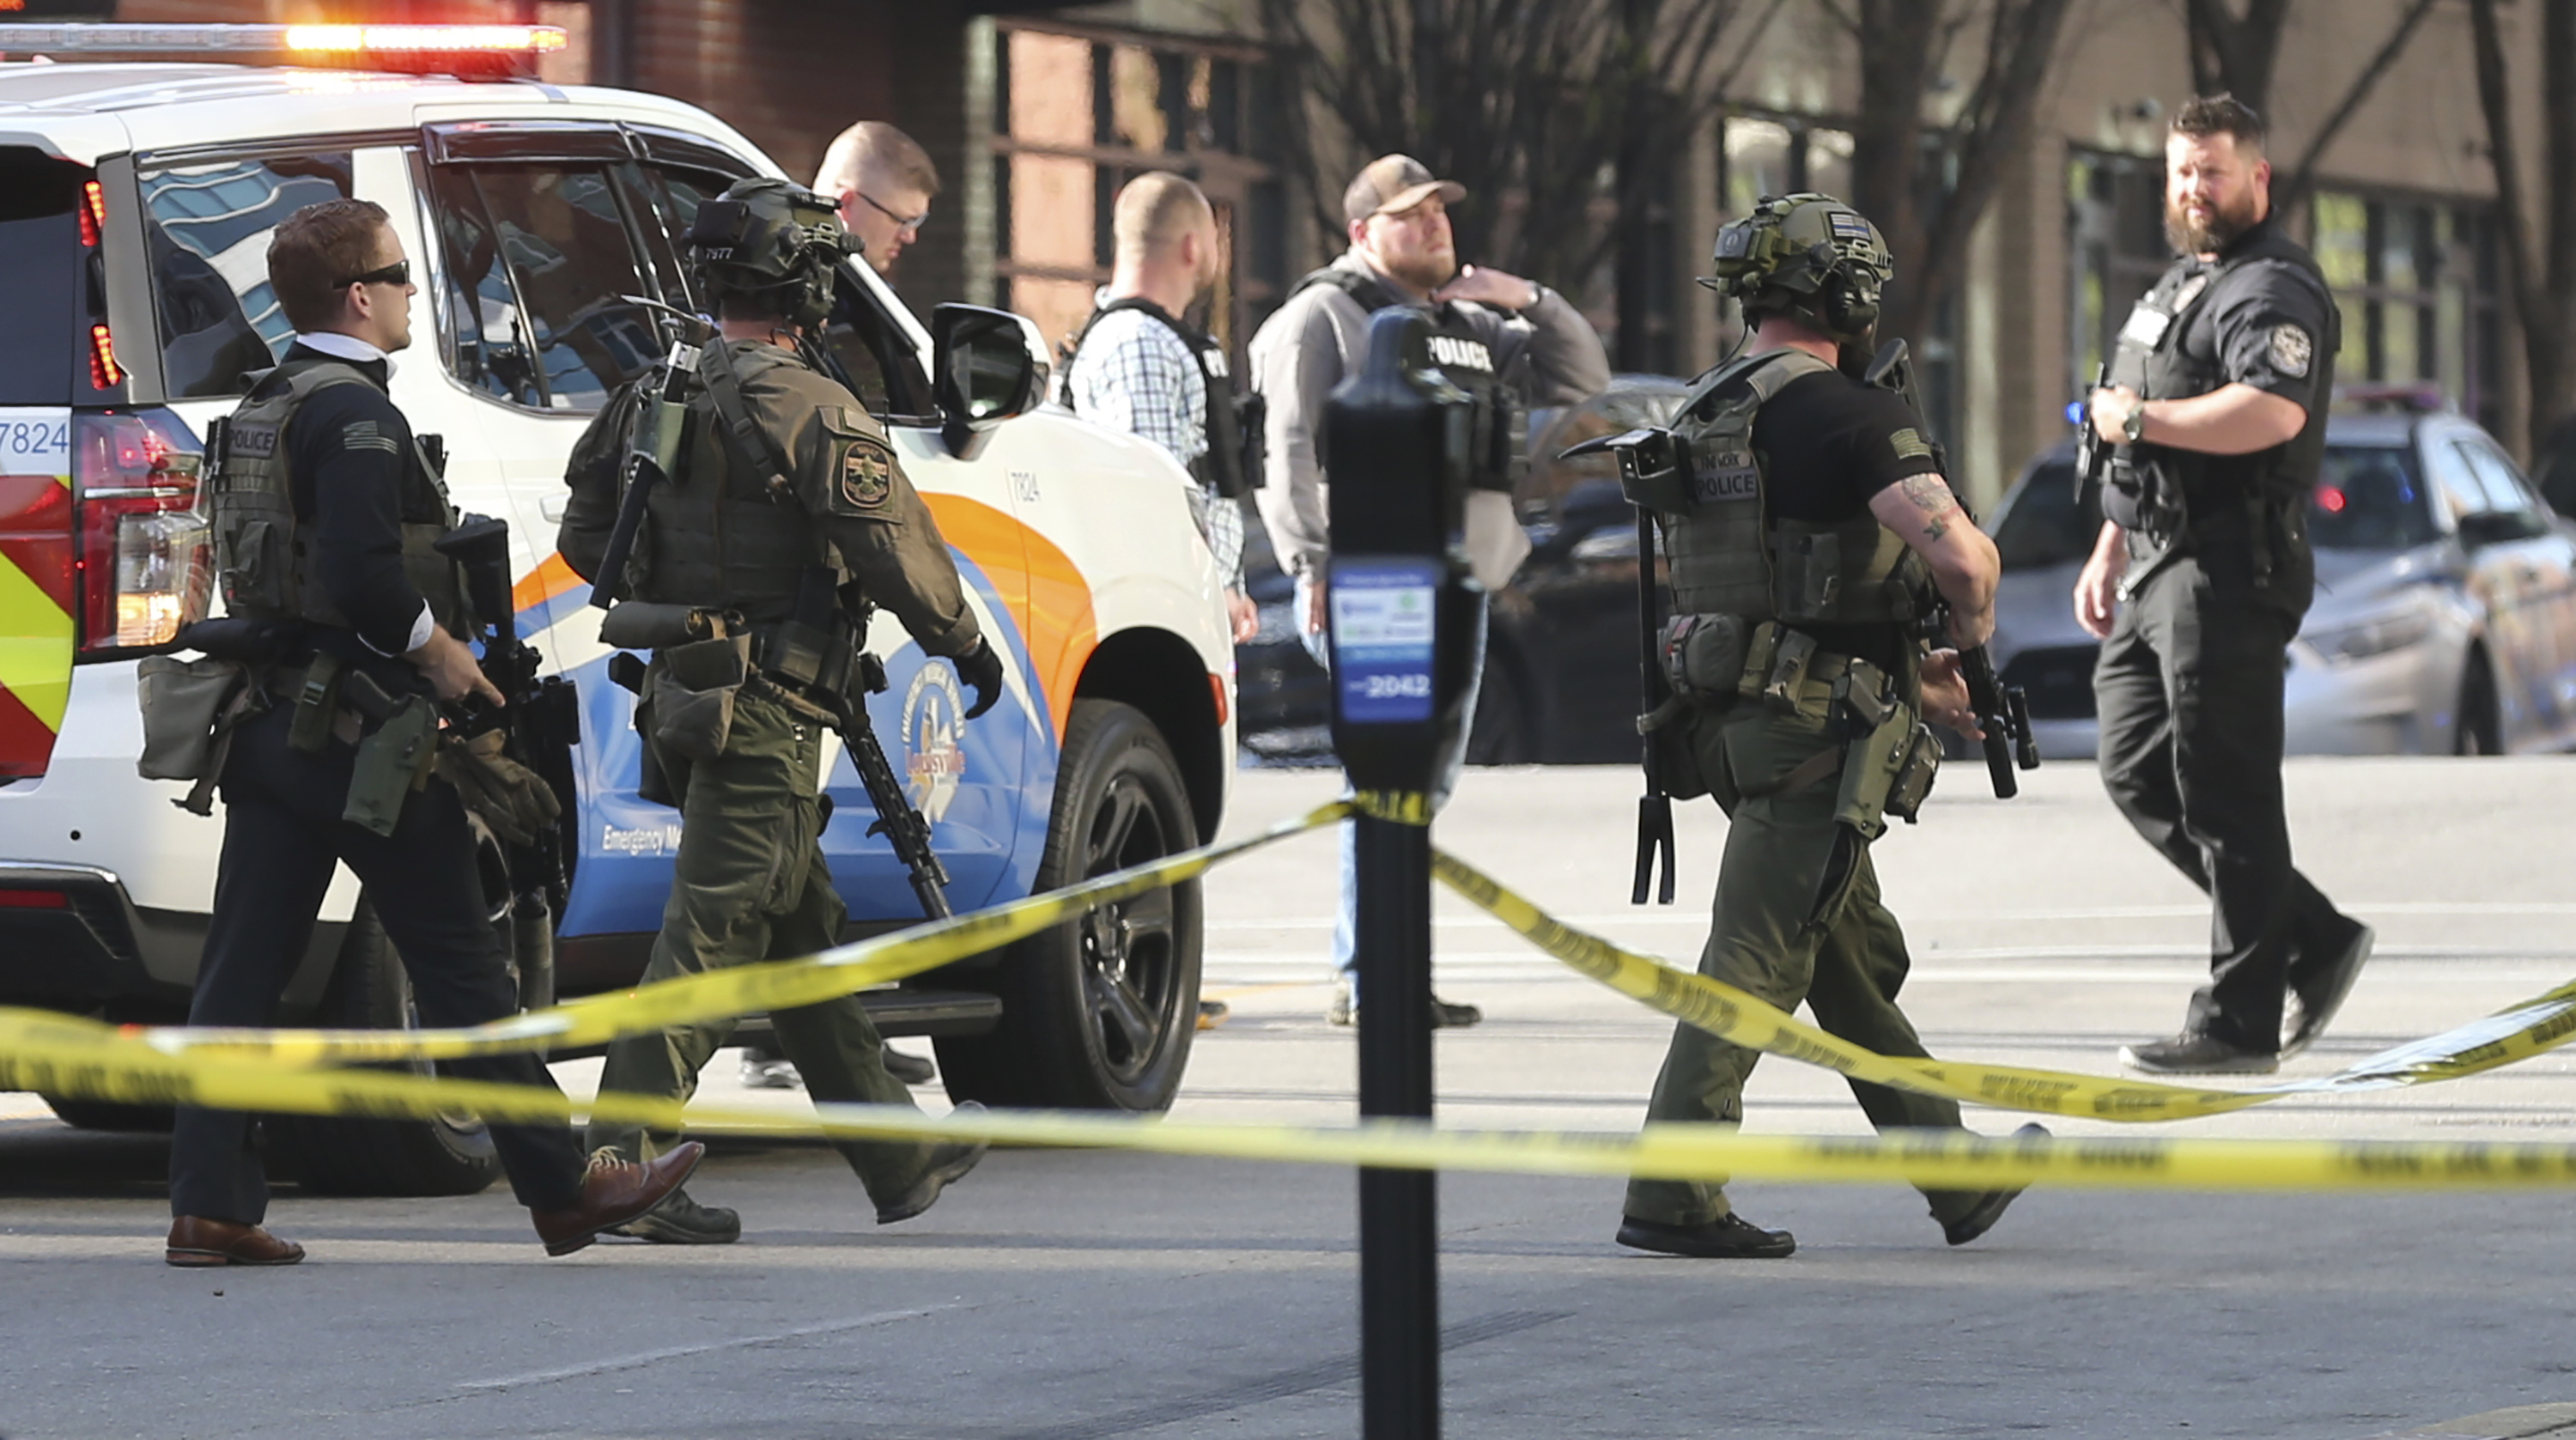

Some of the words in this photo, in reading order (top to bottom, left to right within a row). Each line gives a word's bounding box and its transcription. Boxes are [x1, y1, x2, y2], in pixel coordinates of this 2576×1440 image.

[0, 422, 69, 454] 7824
[1698, 473, 1755, 495] POLICE
[603, 824, 664, 857] Emergency
